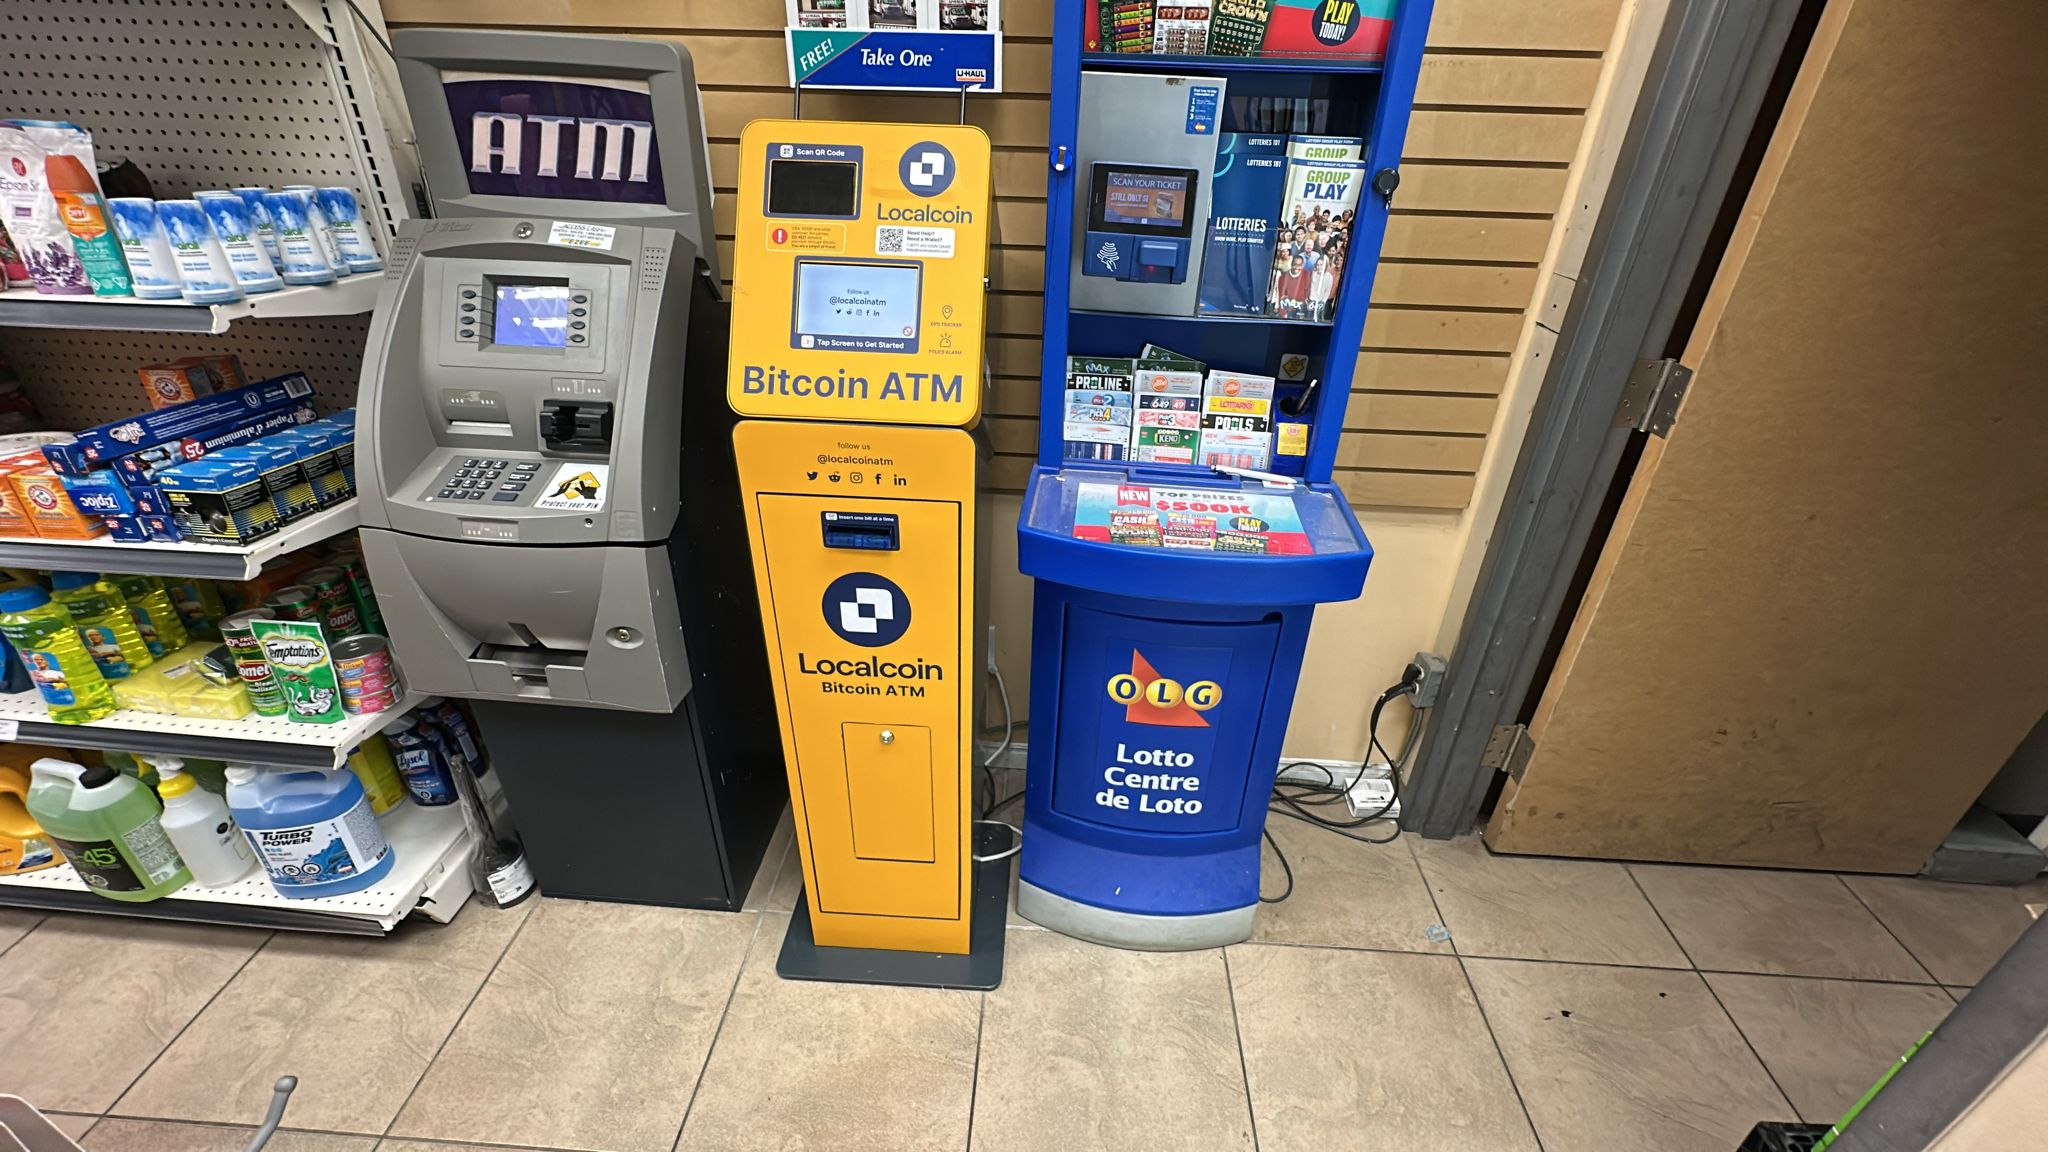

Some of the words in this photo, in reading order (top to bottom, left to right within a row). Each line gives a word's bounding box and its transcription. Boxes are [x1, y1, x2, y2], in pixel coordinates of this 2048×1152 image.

[1218, 3, 1269, 23] CROWN
[1323, 0, 1354, 22] PLAY
[1318, 21, 1347, 41] TODAY!
[800, 38, 835, 71] FREE!
[860, 48, 895, 66] Take
[900, 49, 933, 67] One
[957, 69, 985, 78] U-HAUL
[471, 111, 652, 182] ATM
[797, 148, 814, 156] Scan
[815, 148, 825, 157] QR
[827, 149, 845, 157] Code
[1246, 159, 1273, 167] LOTTERIES
[1113, 178, 1133, 186] SCAN
[1134, 179, 1156, 188] YOUR
[1156, 181, 1182, 190] TICKET
[1306, 169, 1351, 184] GROUP
[1303, 182, 1348, 200] PLAY
[877, 202, 973, 225] Localcoin
[1215, 216, 1267, 232] LOTTERIES
[829, 296, 887, 306] @localcoinatm
[817, 338, 830, 347] Tap
[831, 339, 856, 348] Screen
[879, 341, 905, 349] Started
[743, 365, 869, 399] Bitcoin
[879, 372, 963, 403] ATM
[1075, 375, 1123, 391] PROLINE
[265, 412, 296, 428] Papier
[1214, 415, 1255, 432] POOLS
[205, 423, 263, 450] d'aluminium
[1158, 434, 1178, 443] KENO
[837, 442, 860, 450] follow
[817, 454, 894, 466] @localcoinatm
[79, 493, 119, 509] Ziploc
[1119, 485, 1150, 503] NEW
[1192, 493, 1245, 501] PRIZES
[540, 500, 567, 508] Protect
[1156, 500, 1253, 515] $500K
[1114, 515, 1147, 525] CASH
[1238, 517, 1262, 528] PLAY
[265, 643, 321, 661] Temptations
[798, 652, 943, 681] Localcoin
[822, 682, 881, 695] Bitcoin
[885, 685, 925, 697] ATM
[1115, 679, 1213, 706] OLG
[399, 750, 425, 767] Lysol
[1116, 743, 1195, 768] Lotto
[1104, 766, 1200, 791] Centre
[1095, 788, 1130, 810] de
[1139, 794, 1203, 815] Loto
[259, 829, 314, 842] TURBO
[262, 837, 312, 847] POWER
